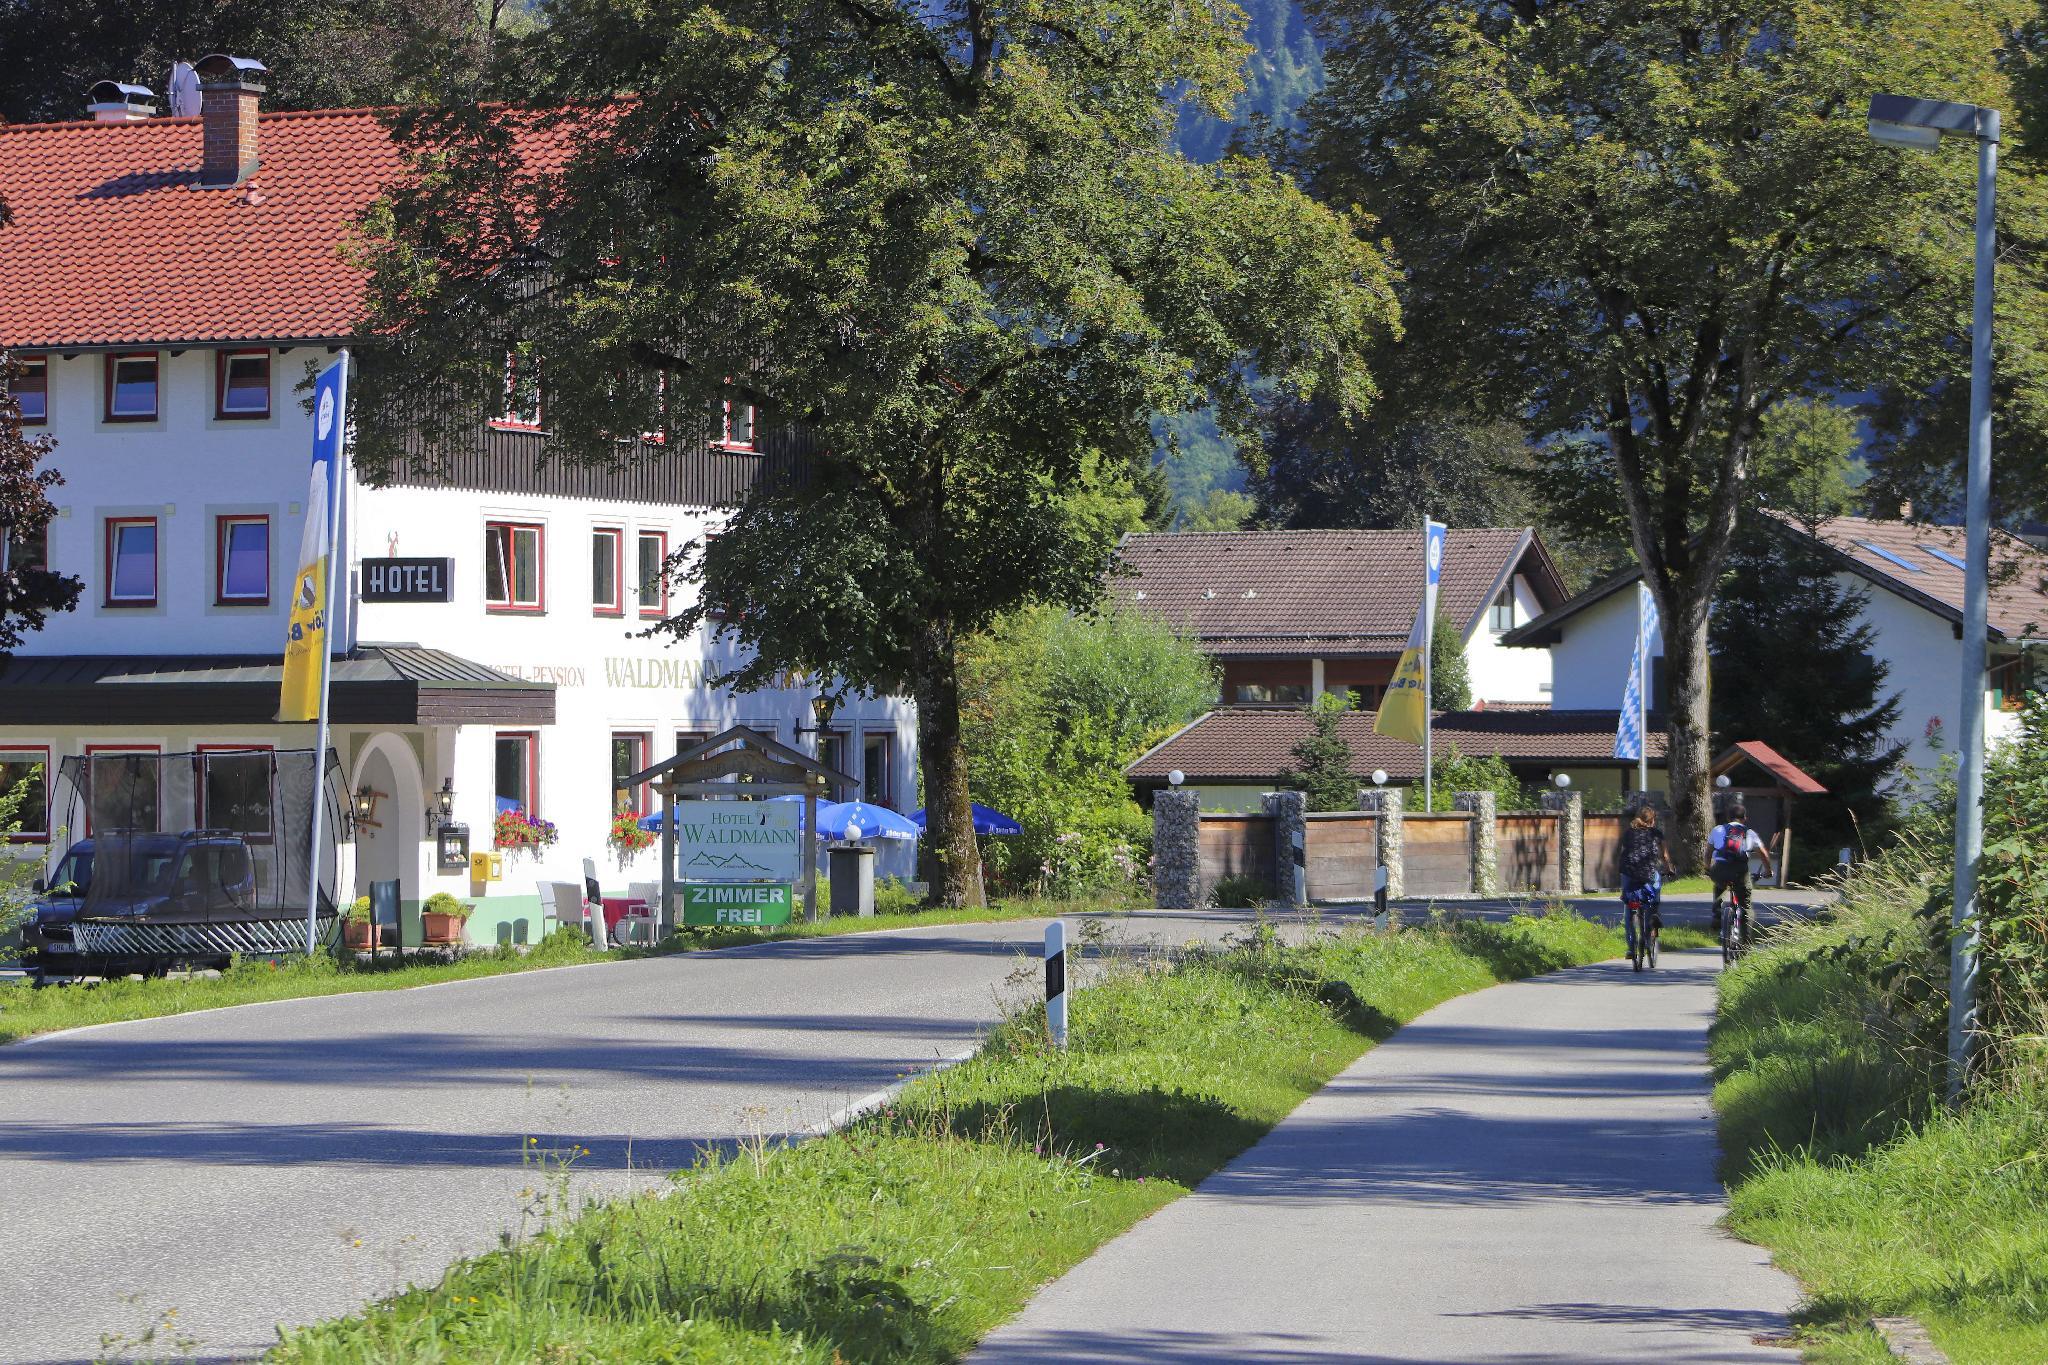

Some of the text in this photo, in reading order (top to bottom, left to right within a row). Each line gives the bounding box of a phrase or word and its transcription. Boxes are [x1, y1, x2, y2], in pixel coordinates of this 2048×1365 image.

[369, 566, 443, 593] HOTEL
[489, 663, 585, 687] TEL-PENSION
[604, 657, 721, 689] WALDMANN
[692, 887, 785, 904] ZIMMER
[716, 908, 762, 922] FREI
